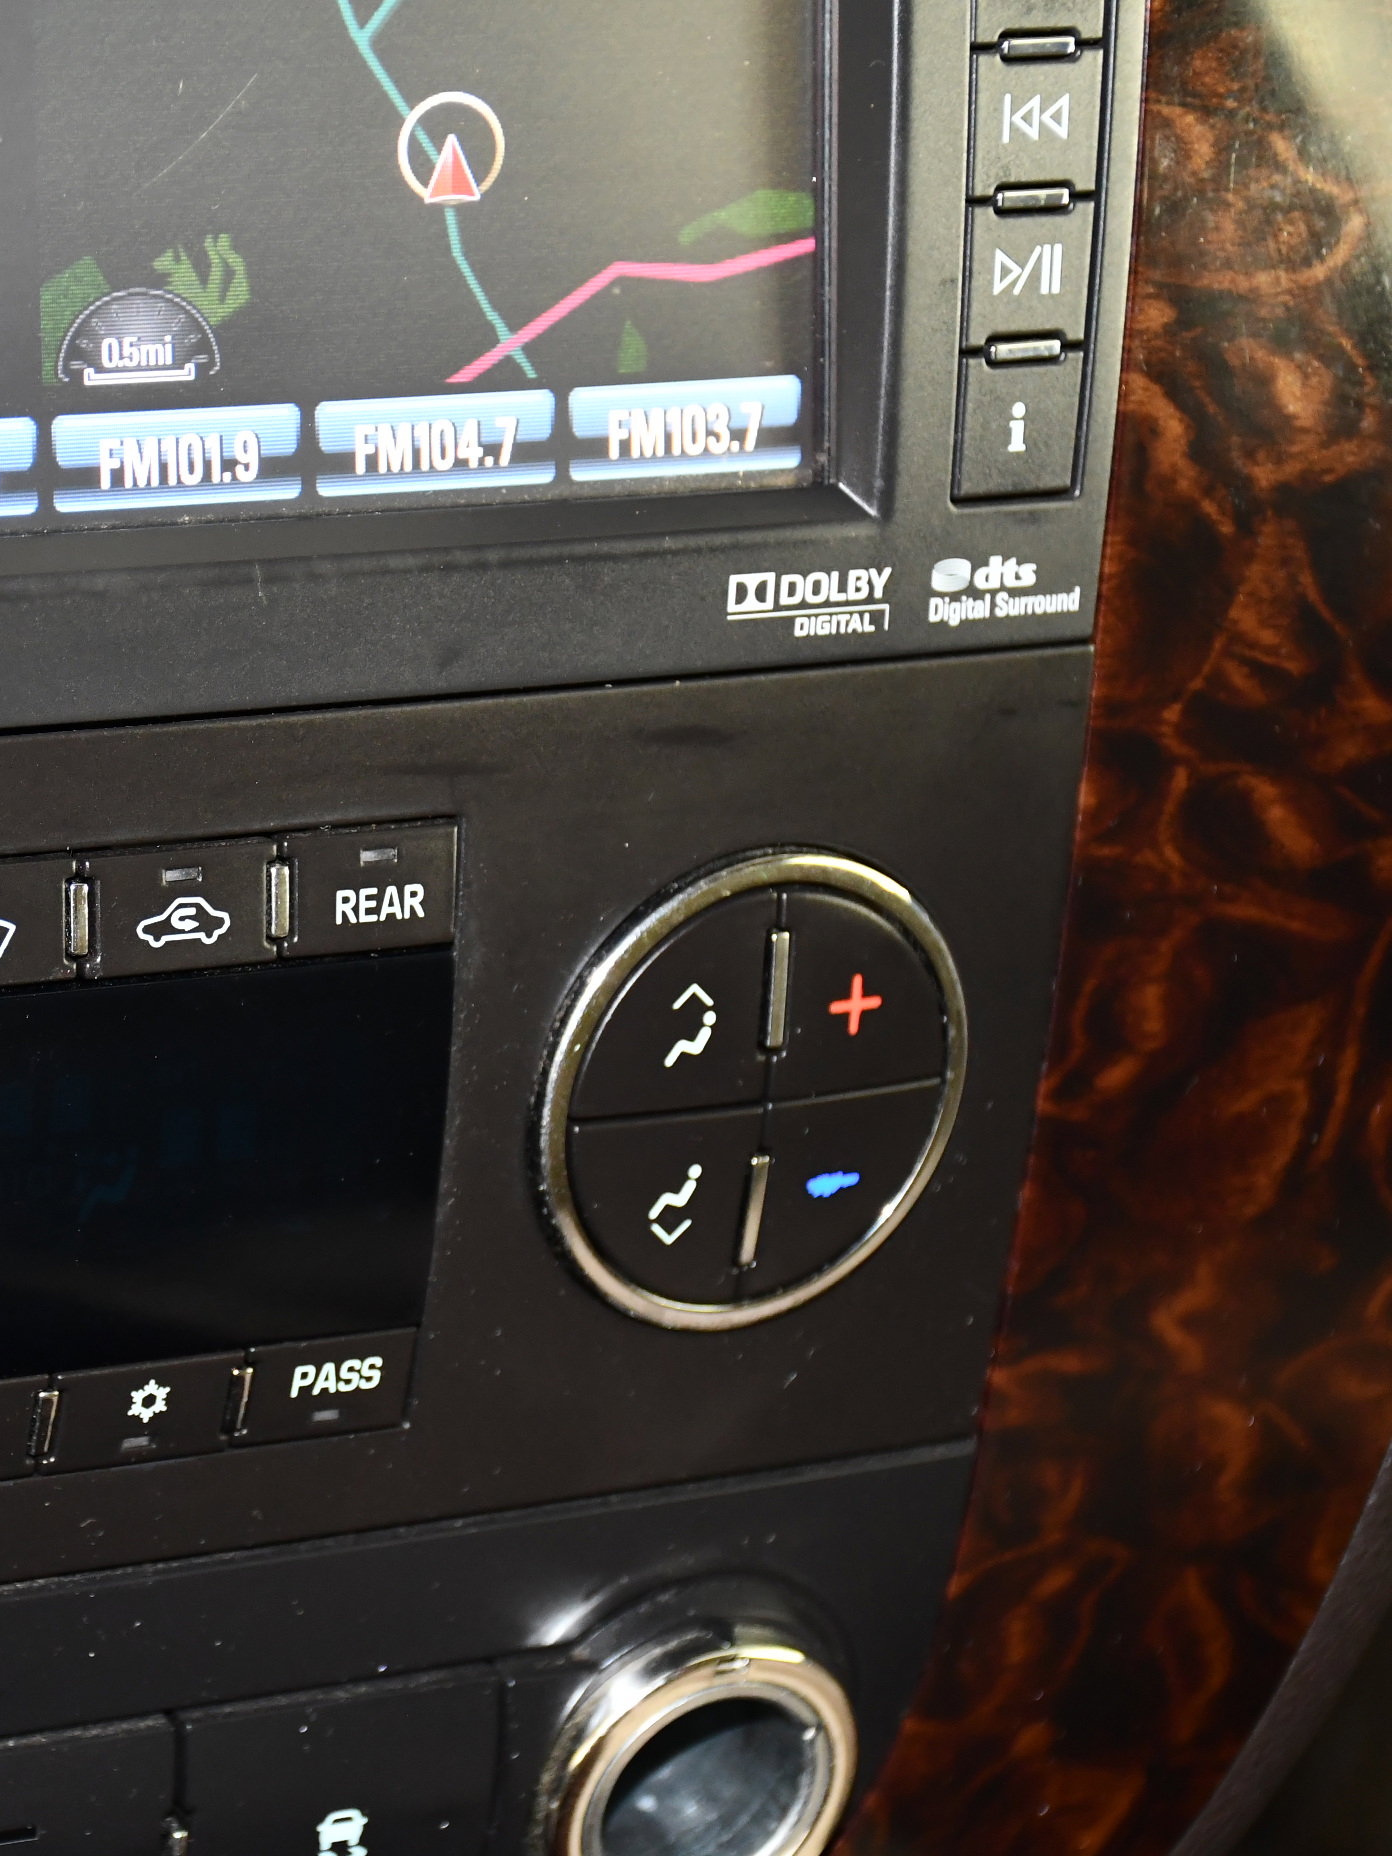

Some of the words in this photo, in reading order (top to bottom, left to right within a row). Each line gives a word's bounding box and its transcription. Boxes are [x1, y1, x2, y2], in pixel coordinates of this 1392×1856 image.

[101, 335, 174, 368] 0.5mi
[354, 416, 519, 474] FM104.7
[608, 402, 764, 460] FM103.7
[99, 431, 260, 489] FM101.9
[778, 566, 893, 606] DOLBY
[973, 555, 1037, 590] dts
[794, 612, 876, 638] DIGITAL
[928, 592, 991, 627] Digital
[994, 585, 1081, 618] Surround
[335, 883, 425, 925] REAR
[290, 1356, 384, 1398] PASS
